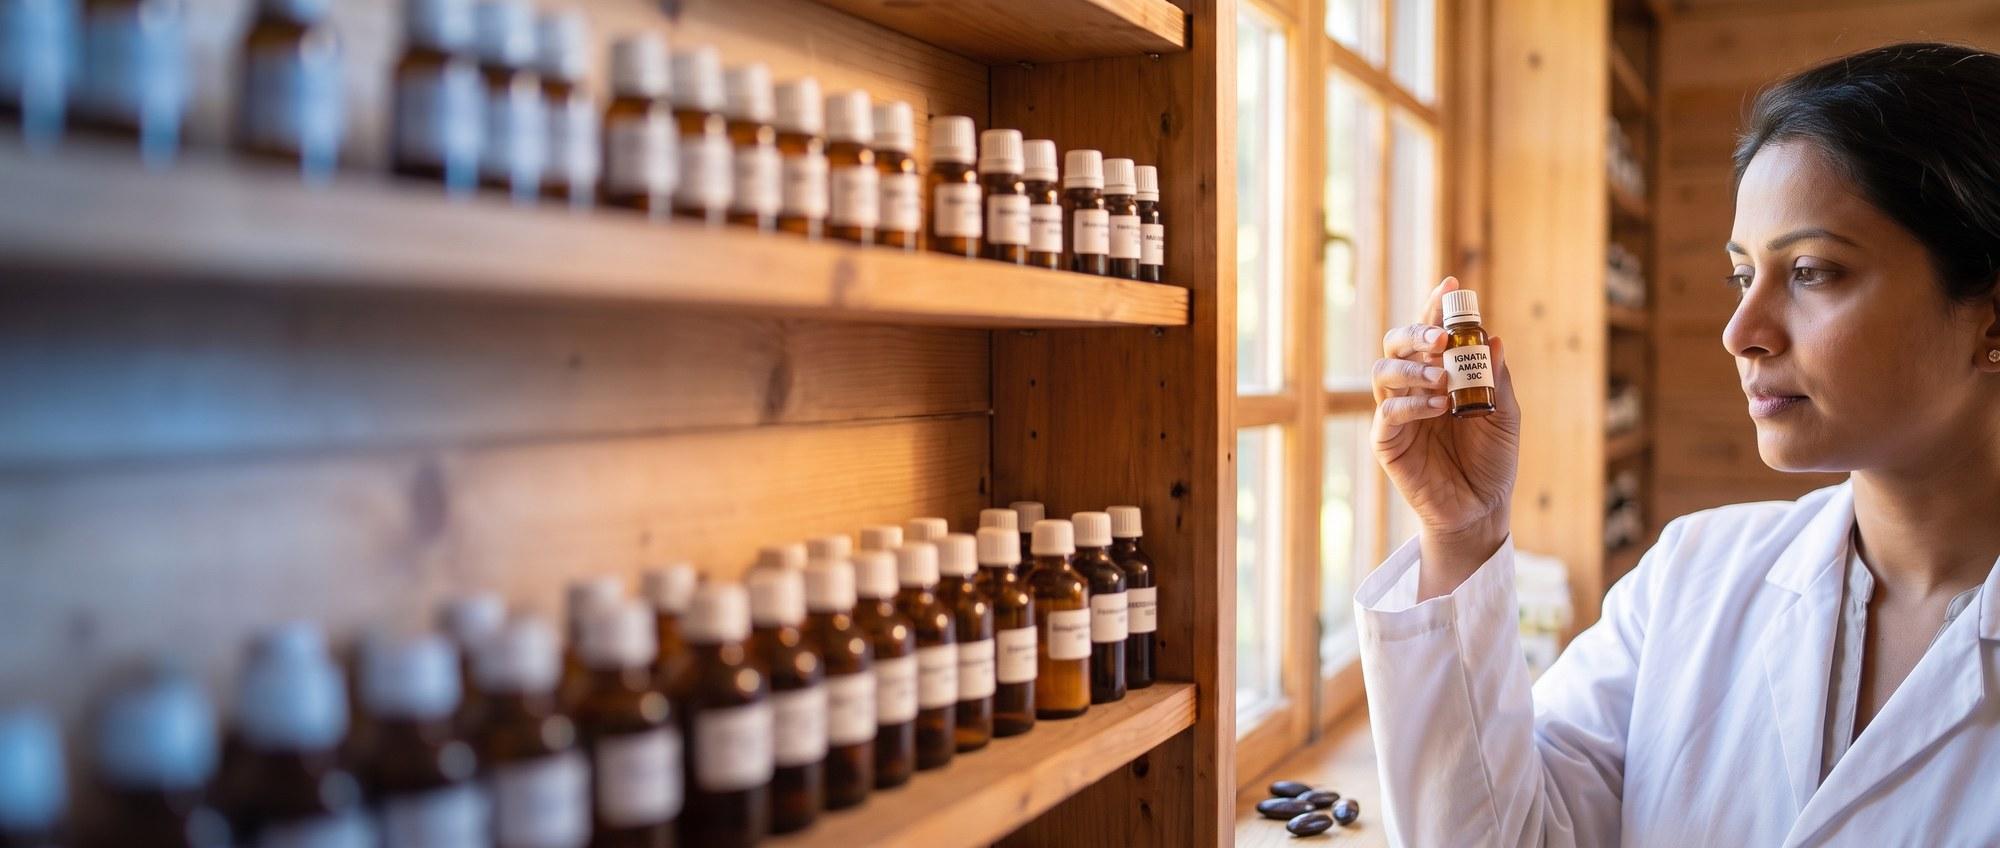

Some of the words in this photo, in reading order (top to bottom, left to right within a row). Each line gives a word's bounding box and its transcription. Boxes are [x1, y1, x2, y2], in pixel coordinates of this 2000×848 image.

[1454, 352, 1488, 363] IGNATIA
[1458, 362, 1488, 372] AMARA
[1466, 371, 1483, 381] 30C
